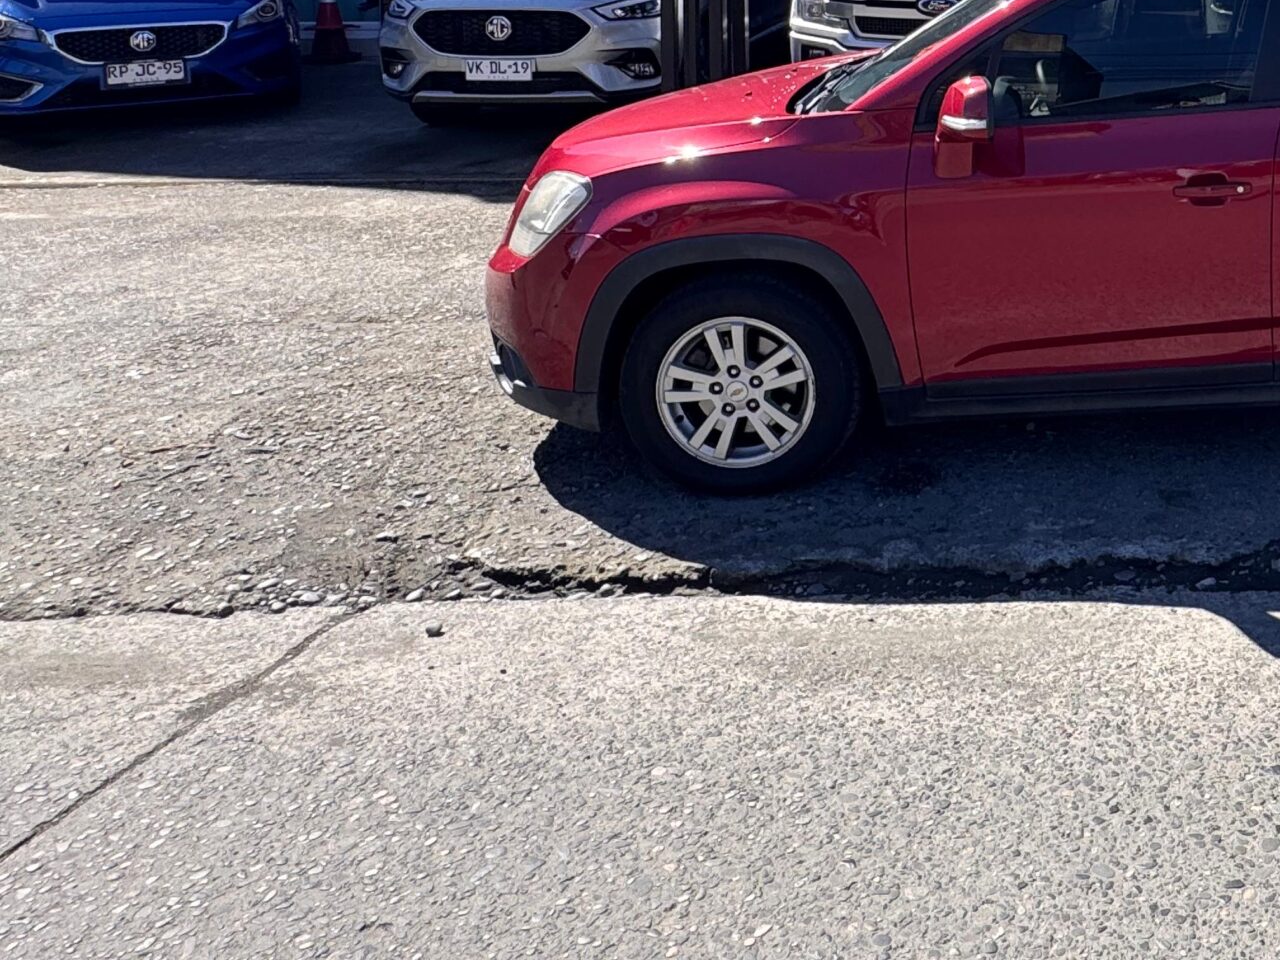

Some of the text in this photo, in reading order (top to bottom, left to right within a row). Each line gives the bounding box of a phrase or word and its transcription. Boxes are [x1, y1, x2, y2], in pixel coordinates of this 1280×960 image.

[486, 17, 509, 38] MG
[132, 32, 155, 50] MG
[107, 65, 129, 79] RP
[467, 61, 484, 74] VK
